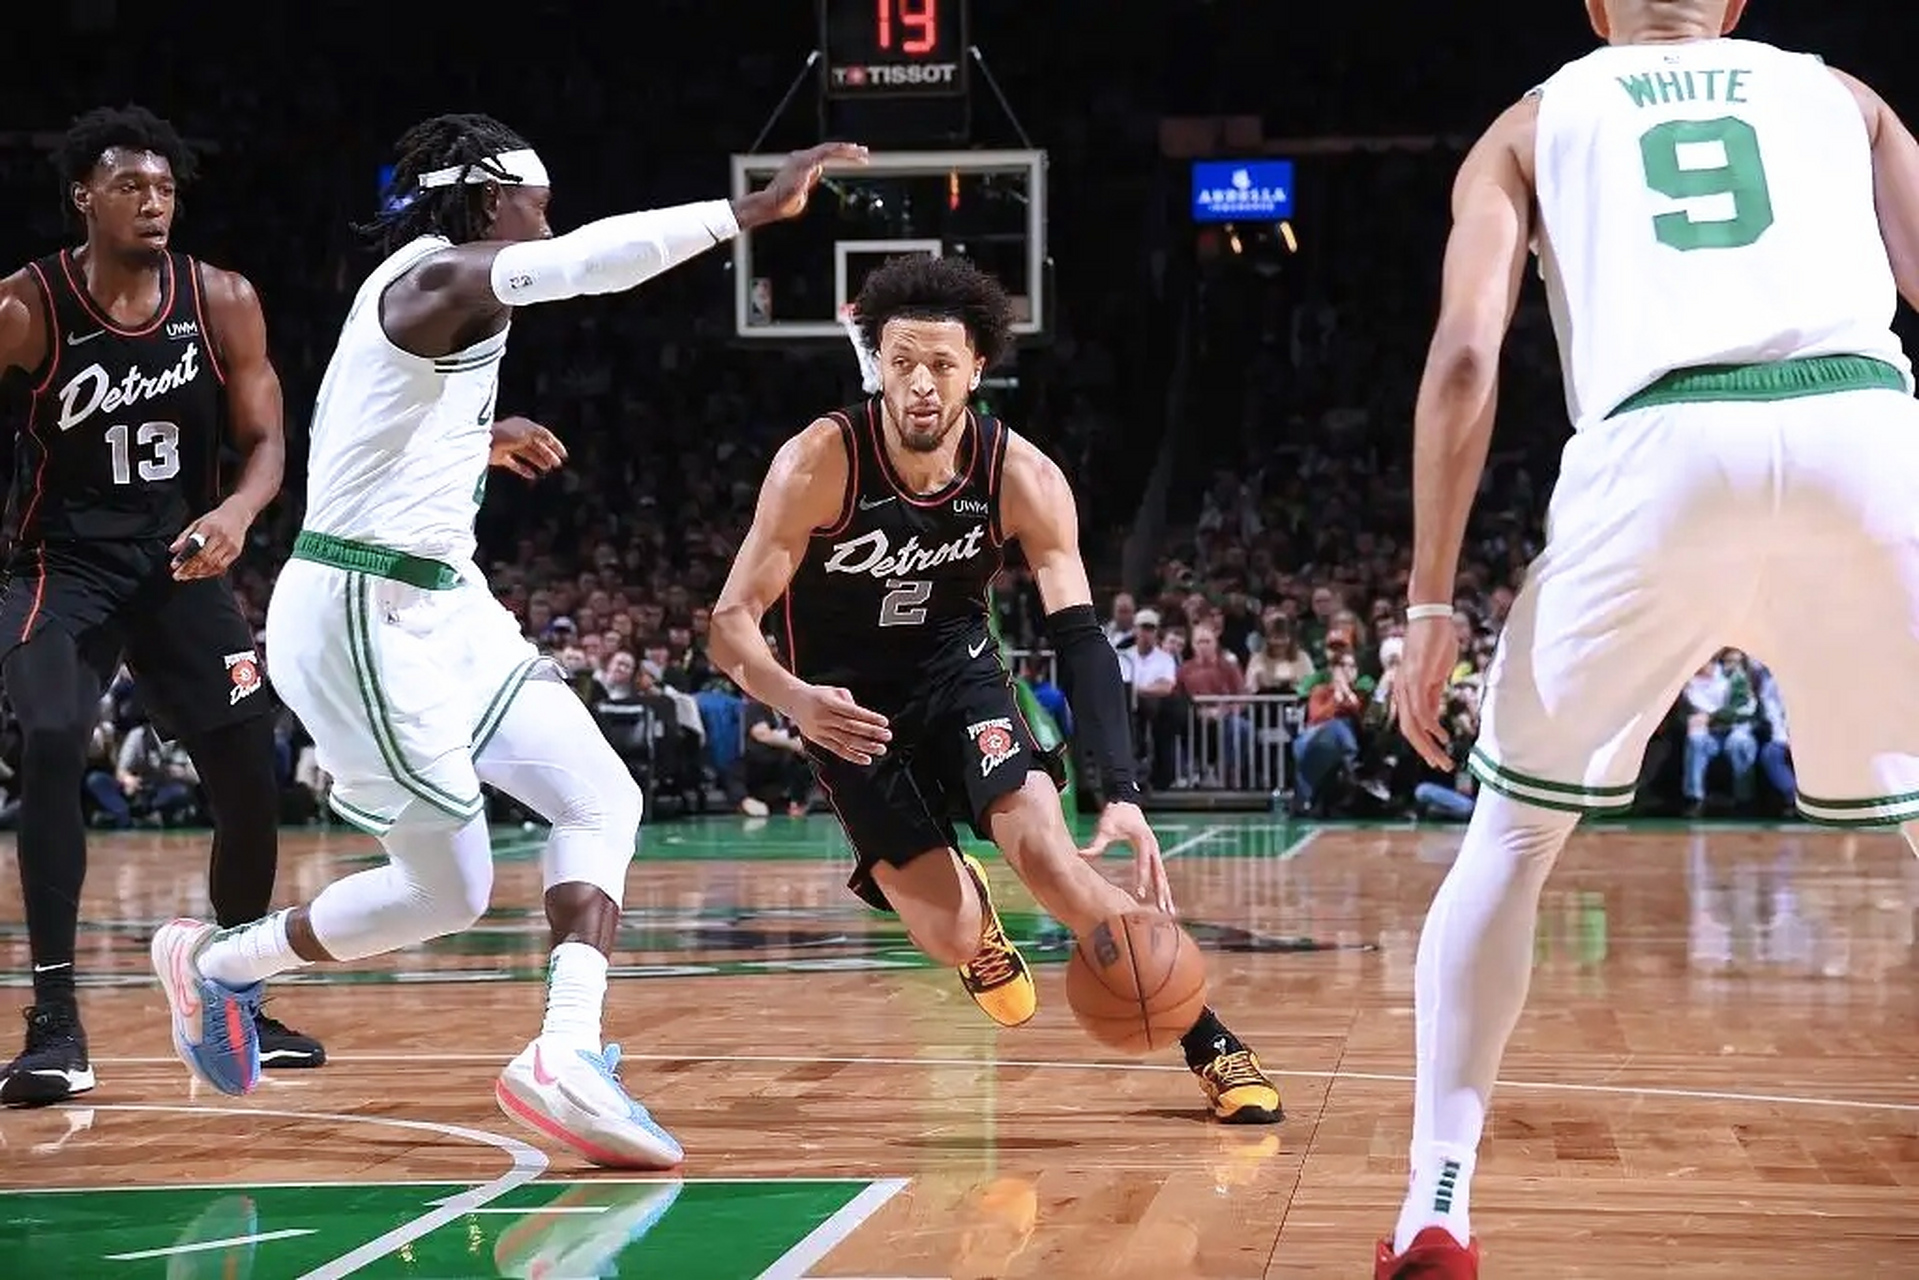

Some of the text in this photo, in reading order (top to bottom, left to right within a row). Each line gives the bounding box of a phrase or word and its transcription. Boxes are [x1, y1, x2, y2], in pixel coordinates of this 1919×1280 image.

[867, 64, 957, 84] TISSOT
[1615, 69, 1752, 108] WHITE
[1639, 115, 1774, 252] 9
[166, 321, 198, 336] UWM
[57, 342, 199, 432] Detroit
[105, 421, 181, 485] 13
[953, 500, 989, 515] UWM
[825, 524, 985, 578] Detroit
[878, 579, 933, 628] 2
